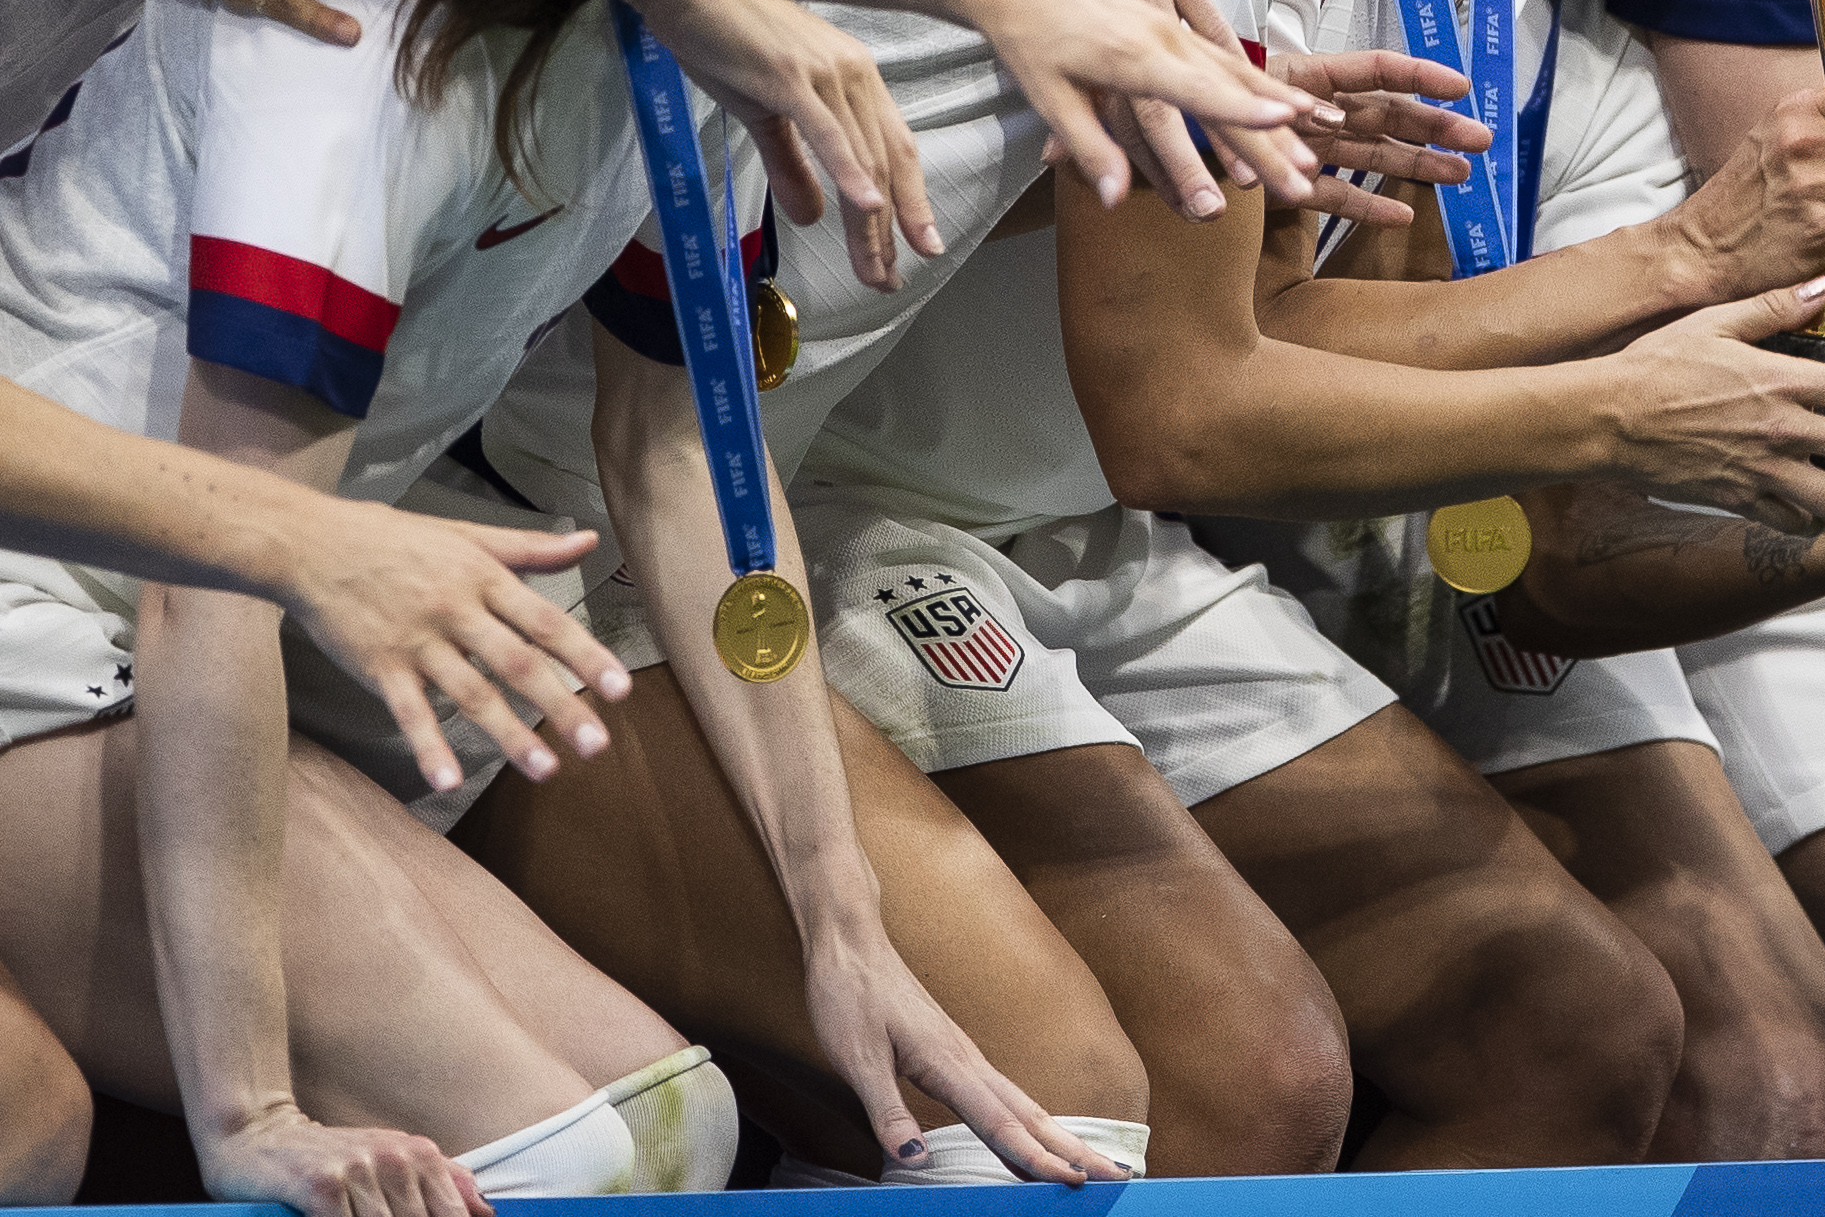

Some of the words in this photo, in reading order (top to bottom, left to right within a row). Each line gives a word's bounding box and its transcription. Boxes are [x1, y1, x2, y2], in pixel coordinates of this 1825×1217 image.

[1419, 2, 1441, 49] FIFA
[1486, 13, 1500, 57] FIFA
[1470, 222, 1491, 269] FIFA
[900, 595, 982, 639] USA
